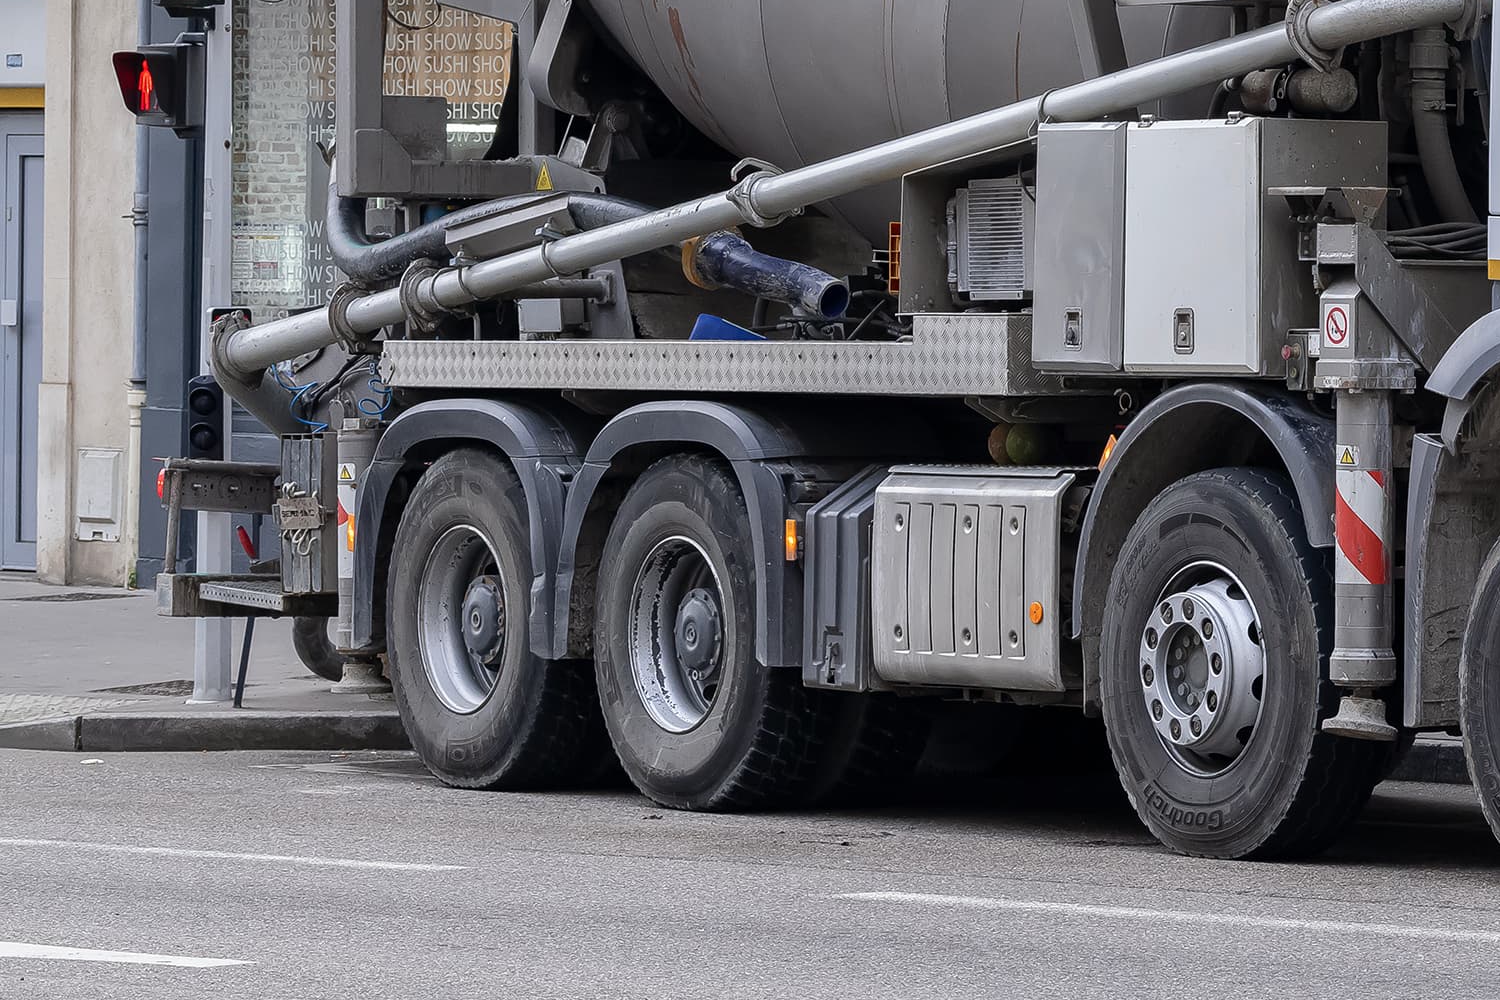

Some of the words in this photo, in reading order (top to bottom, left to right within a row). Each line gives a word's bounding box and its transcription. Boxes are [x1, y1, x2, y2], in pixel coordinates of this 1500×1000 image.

[385, 33, 420, 52] USHI
[424, 33, 472, 52] SHOW
[474, 32, 513, 52] SUSH
[383, 56, 420, 74] HOW
[424, 55, 468, 74] SUSHI
[384, 79, 420, 96] USHI
[424, 79, 472, 97] SHOW
[474, 79, 508, 97] SUS
[472, 102, 503, 119] SHO
